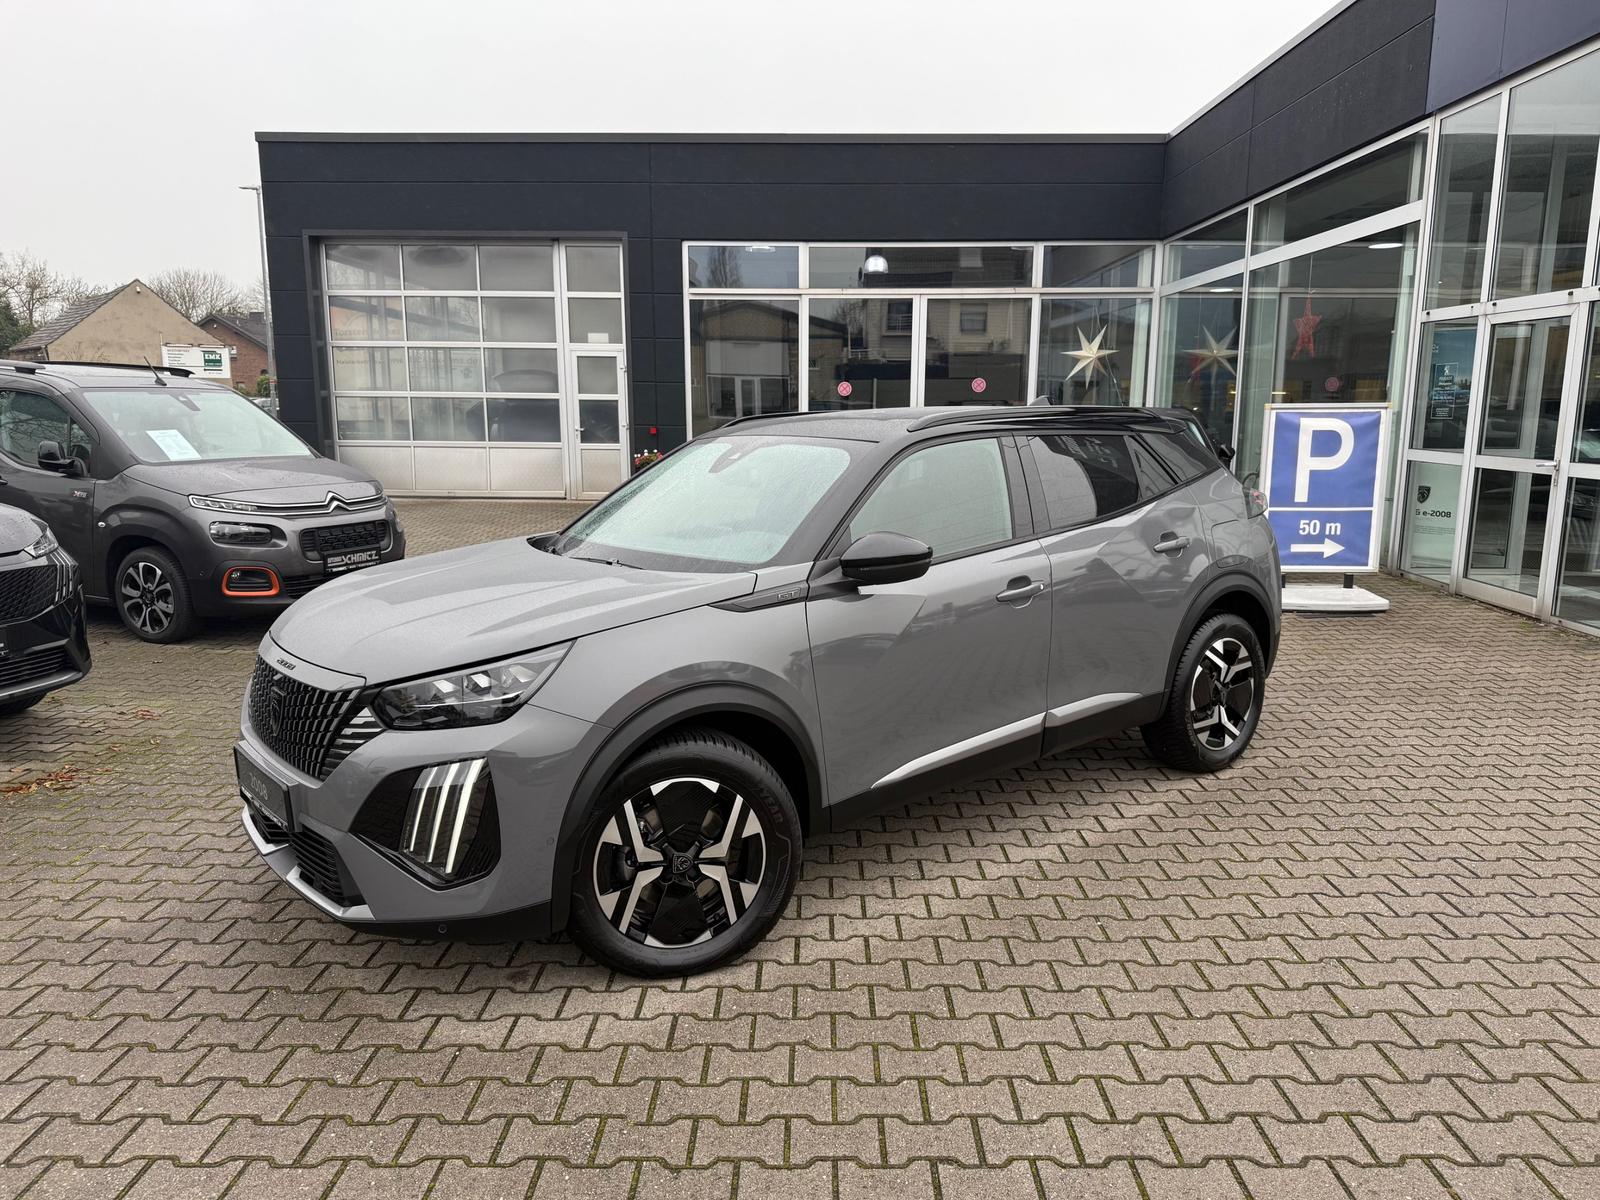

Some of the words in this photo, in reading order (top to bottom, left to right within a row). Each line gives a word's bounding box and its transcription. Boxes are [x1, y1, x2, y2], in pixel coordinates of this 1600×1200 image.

[1294, 417, 1354, 502] P
[1299, 519, 1320, 535] 50
[1325, 522, 1341, 535] m
